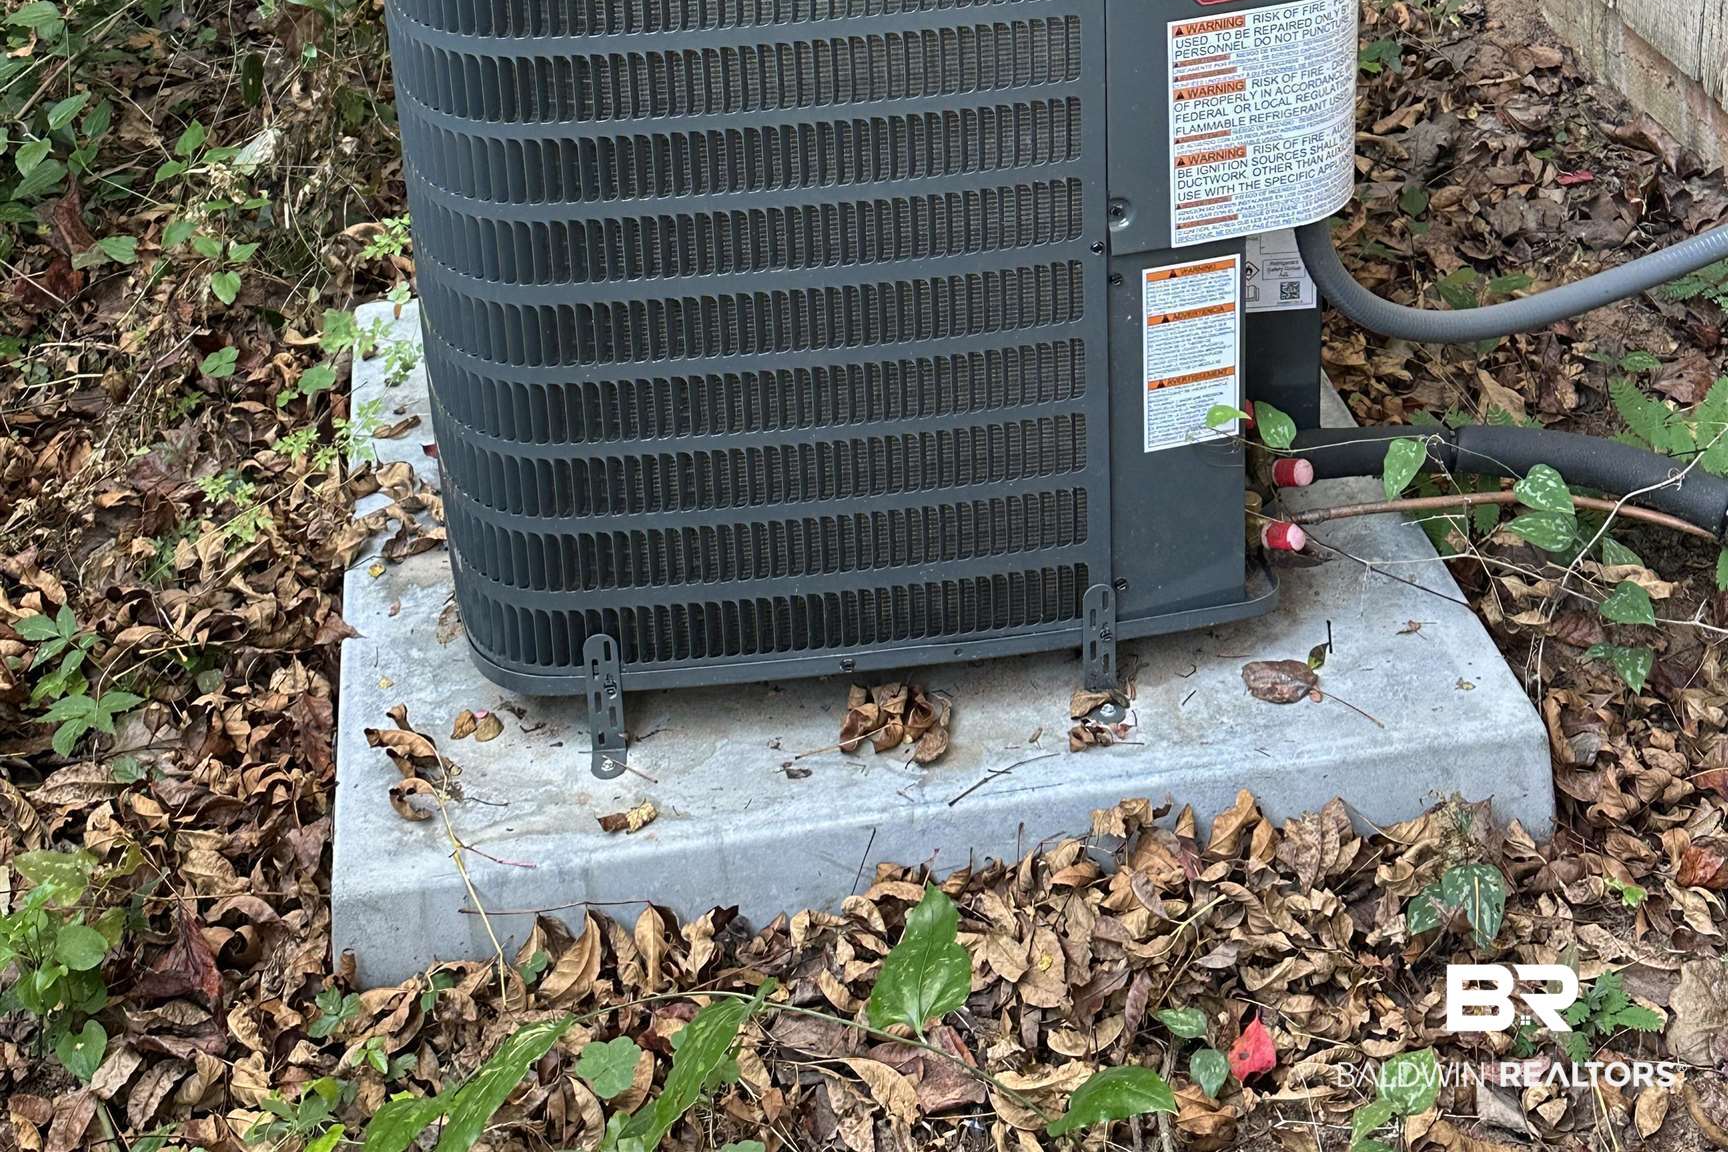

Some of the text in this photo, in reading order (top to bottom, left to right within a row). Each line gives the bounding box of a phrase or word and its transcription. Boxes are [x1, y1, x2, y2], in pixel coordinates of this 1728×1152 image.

[1176, 35, 1208, 49] USED
[1215, 31, 1232, 43] TO
[1235, 28, 1250, 39] BE
[1254, 18, 1312, 36] REPAIRED
[1315, 9, 1339, 25] ONLY
[1187, 16, 1244, 34] WARNING
[1253, 11, 1280, 24] RISK
[1284, 8, 1299, 19] OF
[1303, 1, 1326, 16] FIRE
[1255, 36, 1271, 47] DO
[1275, 31, 1299, 43] NOT
[1174, 69, 1345, 112] OF PROPERLY IN ACCORDANCE
[1188, 80, 1244, 99] WARNING
[1252, 75, 1279, 88] RISK
[1282, 72, 1297, 83] OF
[1301, 65, 1324, 80] FIRE
[1175, 108, 1229, 124] FEDERAL
[1234, 103, 1251, 114] OR
[1255, 97, 1292, 111] LOCAL
[1175, 116, 1246, 136] FLAMMABLE
[1250, 99, 1327, 125] REFRIGERANT
[1177, 168, 1193, 179] BE
[1197, 159, 1248, 175] IGNITION
[1252, 149, 1307, 166] SOURCES
[1310, 138, 1338, 155] SHALL
[1188, 147, 1244, 165] WARNING
[1253, 142, 1280, 154] RISK
[1283, 139, 1298, 149] OF
[1302, 132, 1324, 146] FIRE
[1253, 162, 1293, 176] OTHER
[1296, 155, 1323, 169] THAN
[1178, 190, 1201, 202] USE
[1205, 184, 1235, 197] WITH
[1239, 180, 1261, 192] THE
[1265, 169, 1315, 187] SPECIFIC
